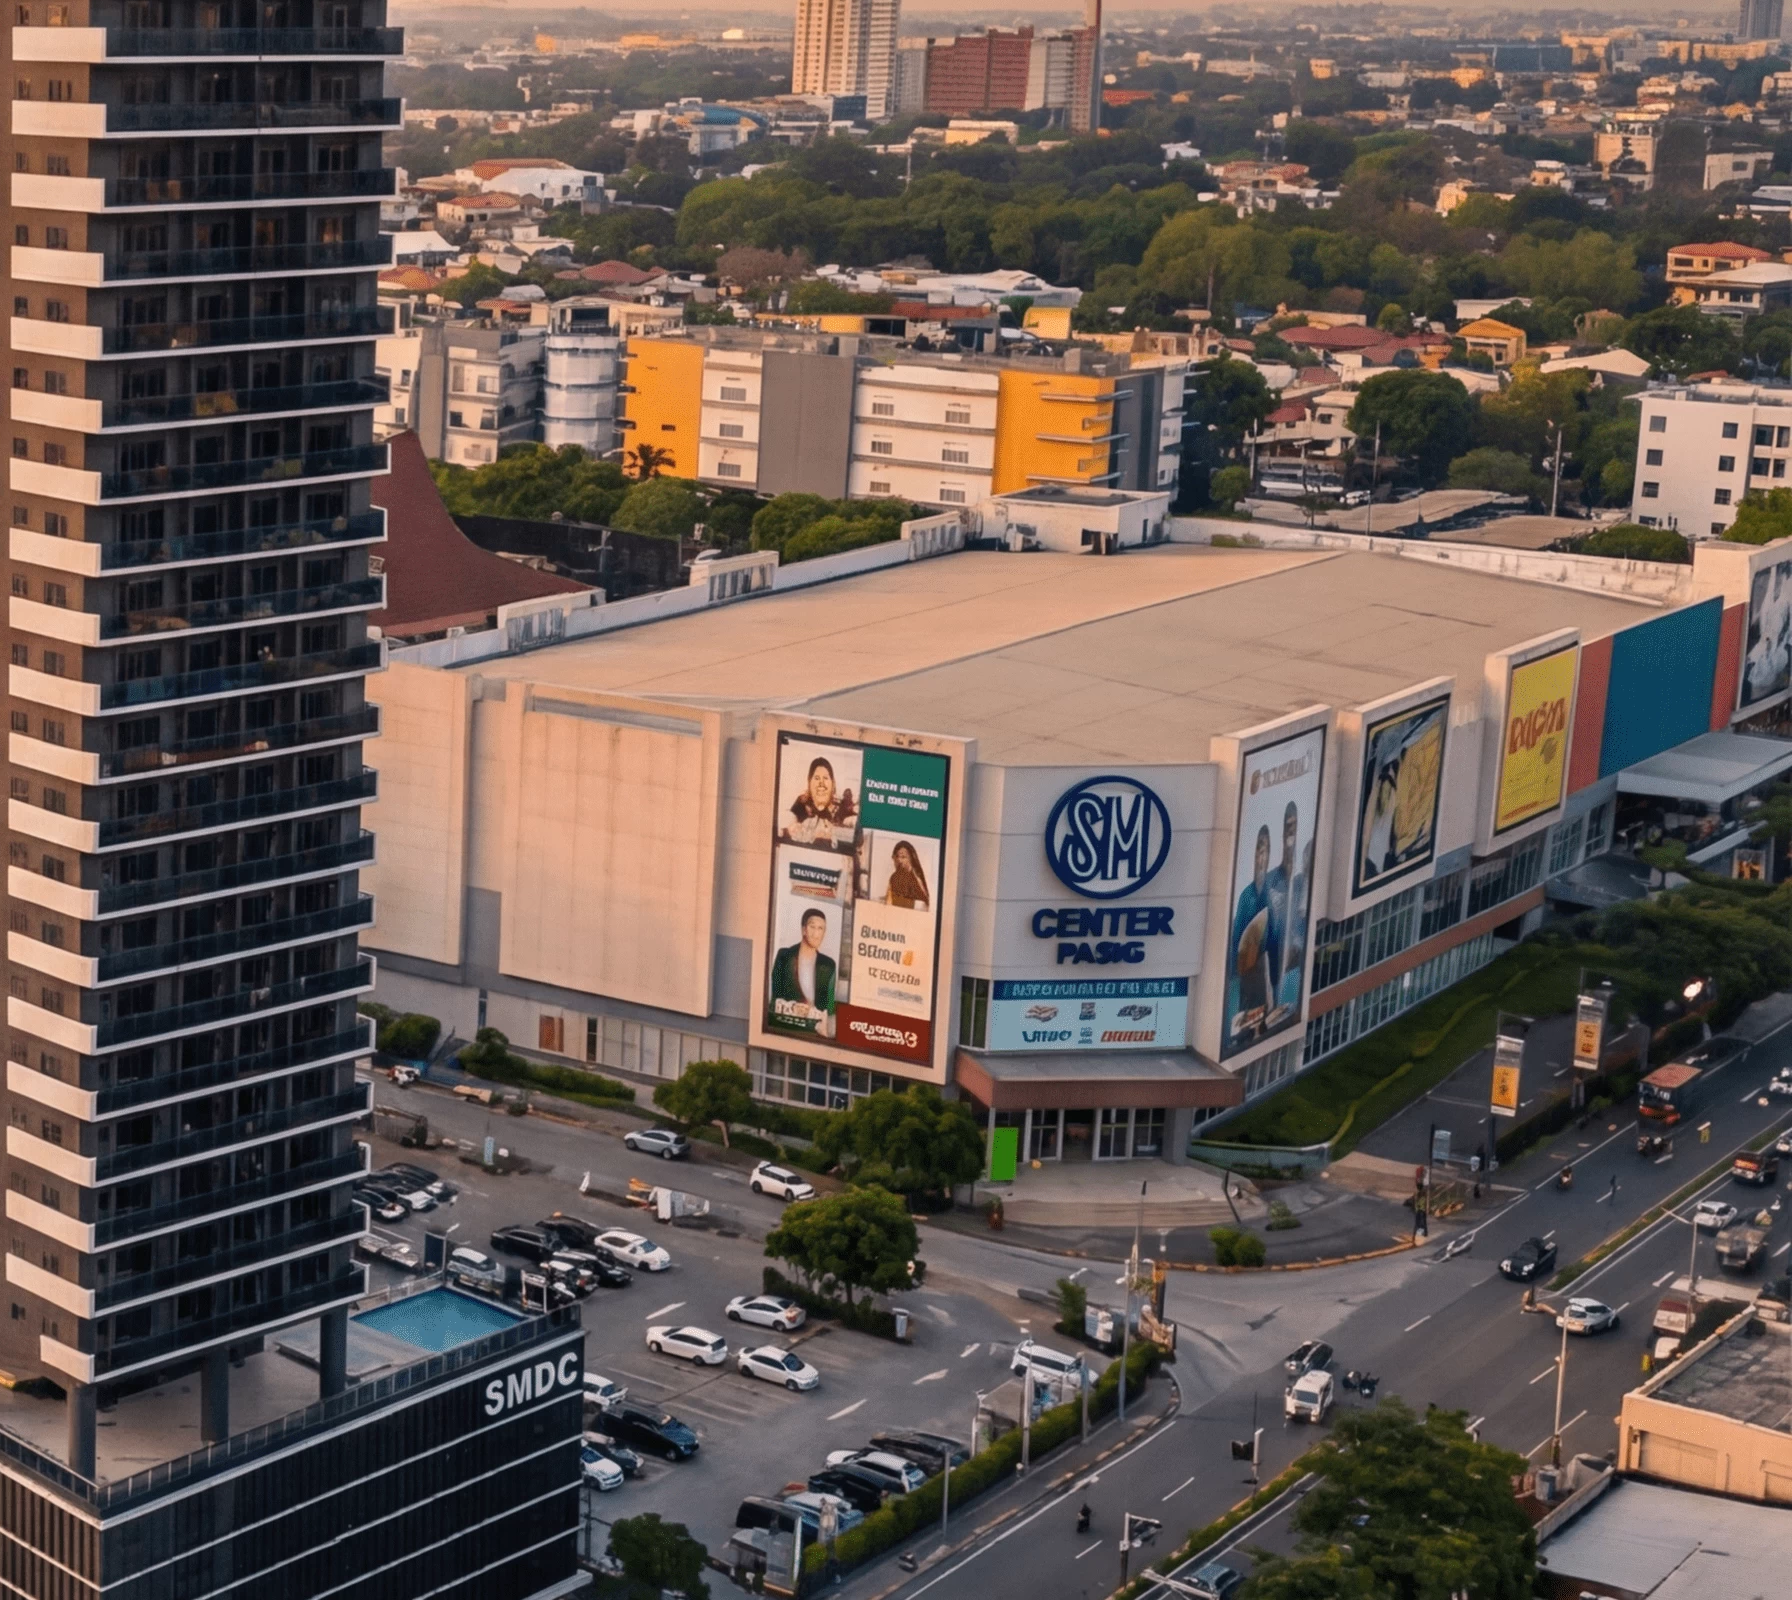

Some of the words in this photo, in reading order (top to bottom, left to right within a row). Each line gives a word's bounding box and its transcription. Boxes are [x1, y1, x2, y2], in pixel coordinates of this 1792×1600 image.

[1056, 789, 1154, 886] SM
[1032, 906, 1175, 938] CENTER
[1056, 941, 1146, 965] PASIG
[484, 1351, 578, 1416] SMDC
